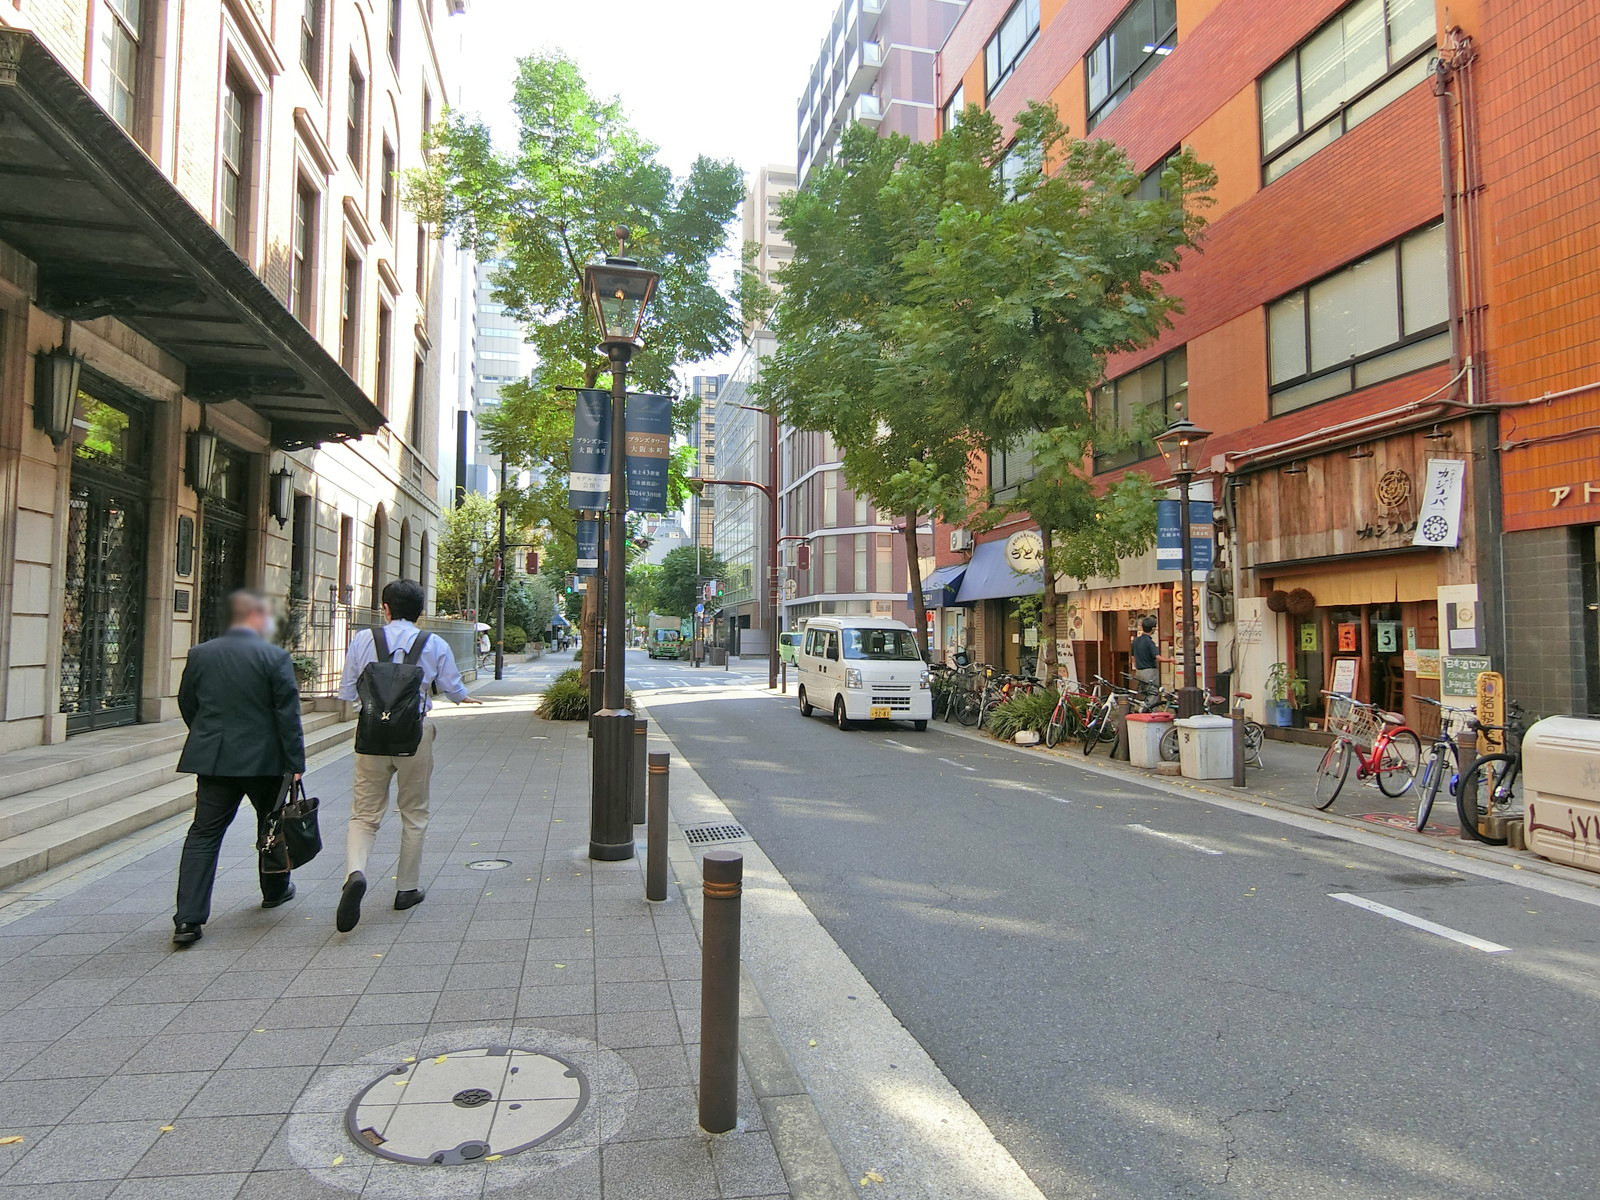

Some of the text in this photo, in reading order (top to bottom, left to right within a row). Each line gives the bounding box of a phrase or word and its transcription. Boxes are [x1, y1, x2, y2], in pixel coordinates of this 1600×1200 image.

[628, 436, 666, 444] ブランズタワー
[578, 446, 606, 456] 大阪本町
[630, 446, 663, 454] 大阪本町
[1011, 548, 1044, 560] うどん
[1382, 630, 1392, 645] 5
[1486, 696, 1495, 752] NO PAKIG
